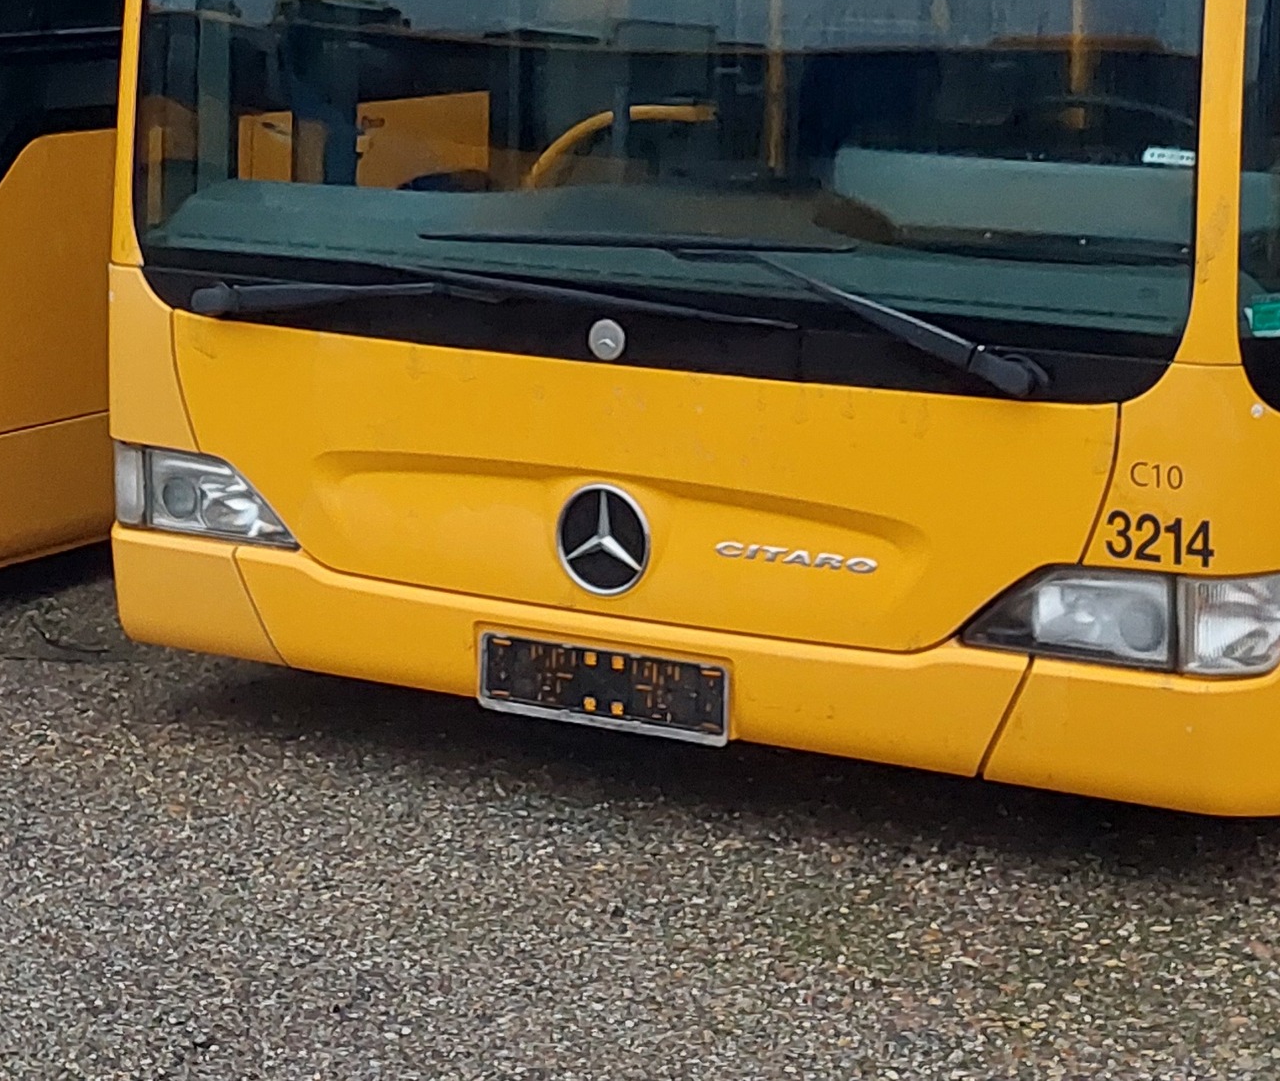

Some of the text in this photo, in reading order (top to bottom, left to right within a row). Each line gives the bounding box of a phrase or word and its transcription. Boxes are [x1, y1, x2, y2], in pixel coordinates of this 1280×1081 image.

[1130, 461, 1184, 490] C10
[1105, 510, 1215, 568] 3214
[715, 541, 878, 574] CITARO
